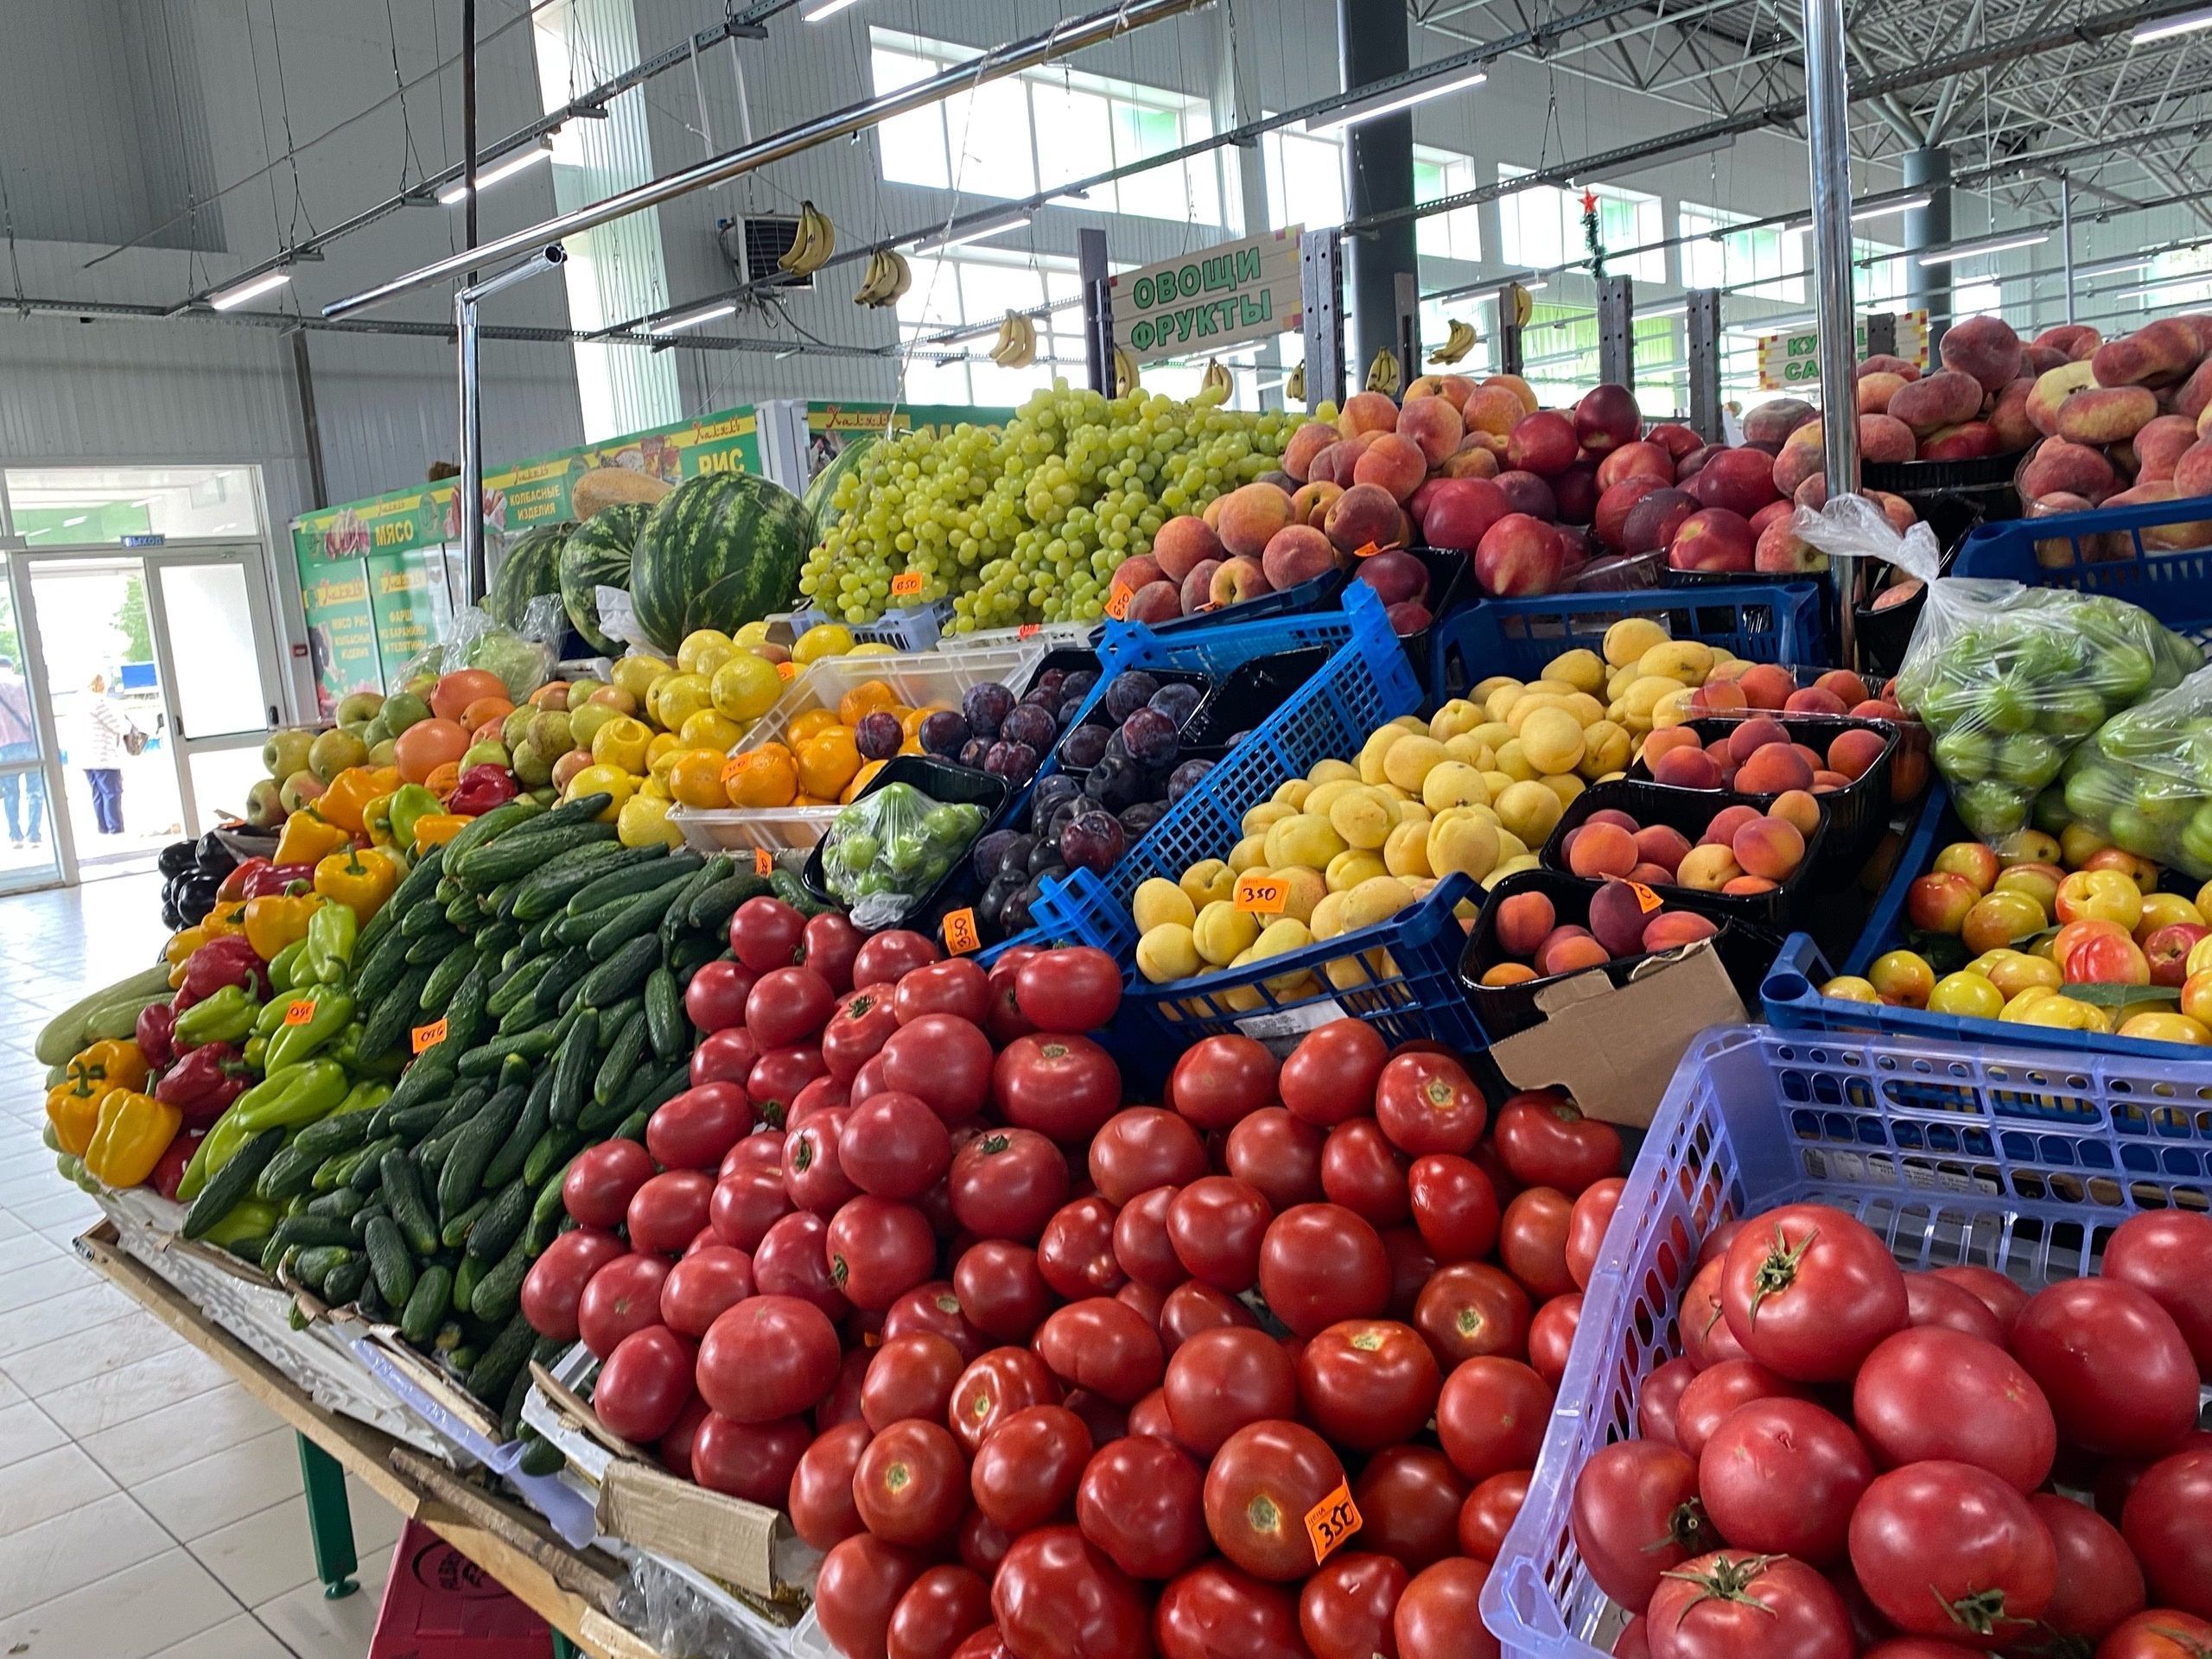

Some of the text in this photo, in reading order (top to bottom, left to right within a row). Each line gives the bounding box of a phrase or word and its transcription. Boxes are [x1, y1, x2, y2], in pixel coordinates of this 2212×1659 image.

[1134, 246, 1261, 308] ОВОЩИ
[1131, 289, 1272, 351] ФРУКТЫ
[698, 448, 745, 474] РИС
[510, 485, 561, 506] КОЛБАСНЫЕ
[518, 502, 556, 521] ИЗДЕЛИЯ
[375, 519, 414, 547] МЯСО
[1243, 887, 1277, 903] 350
[1319, 1502, 1355, 1549] 350
